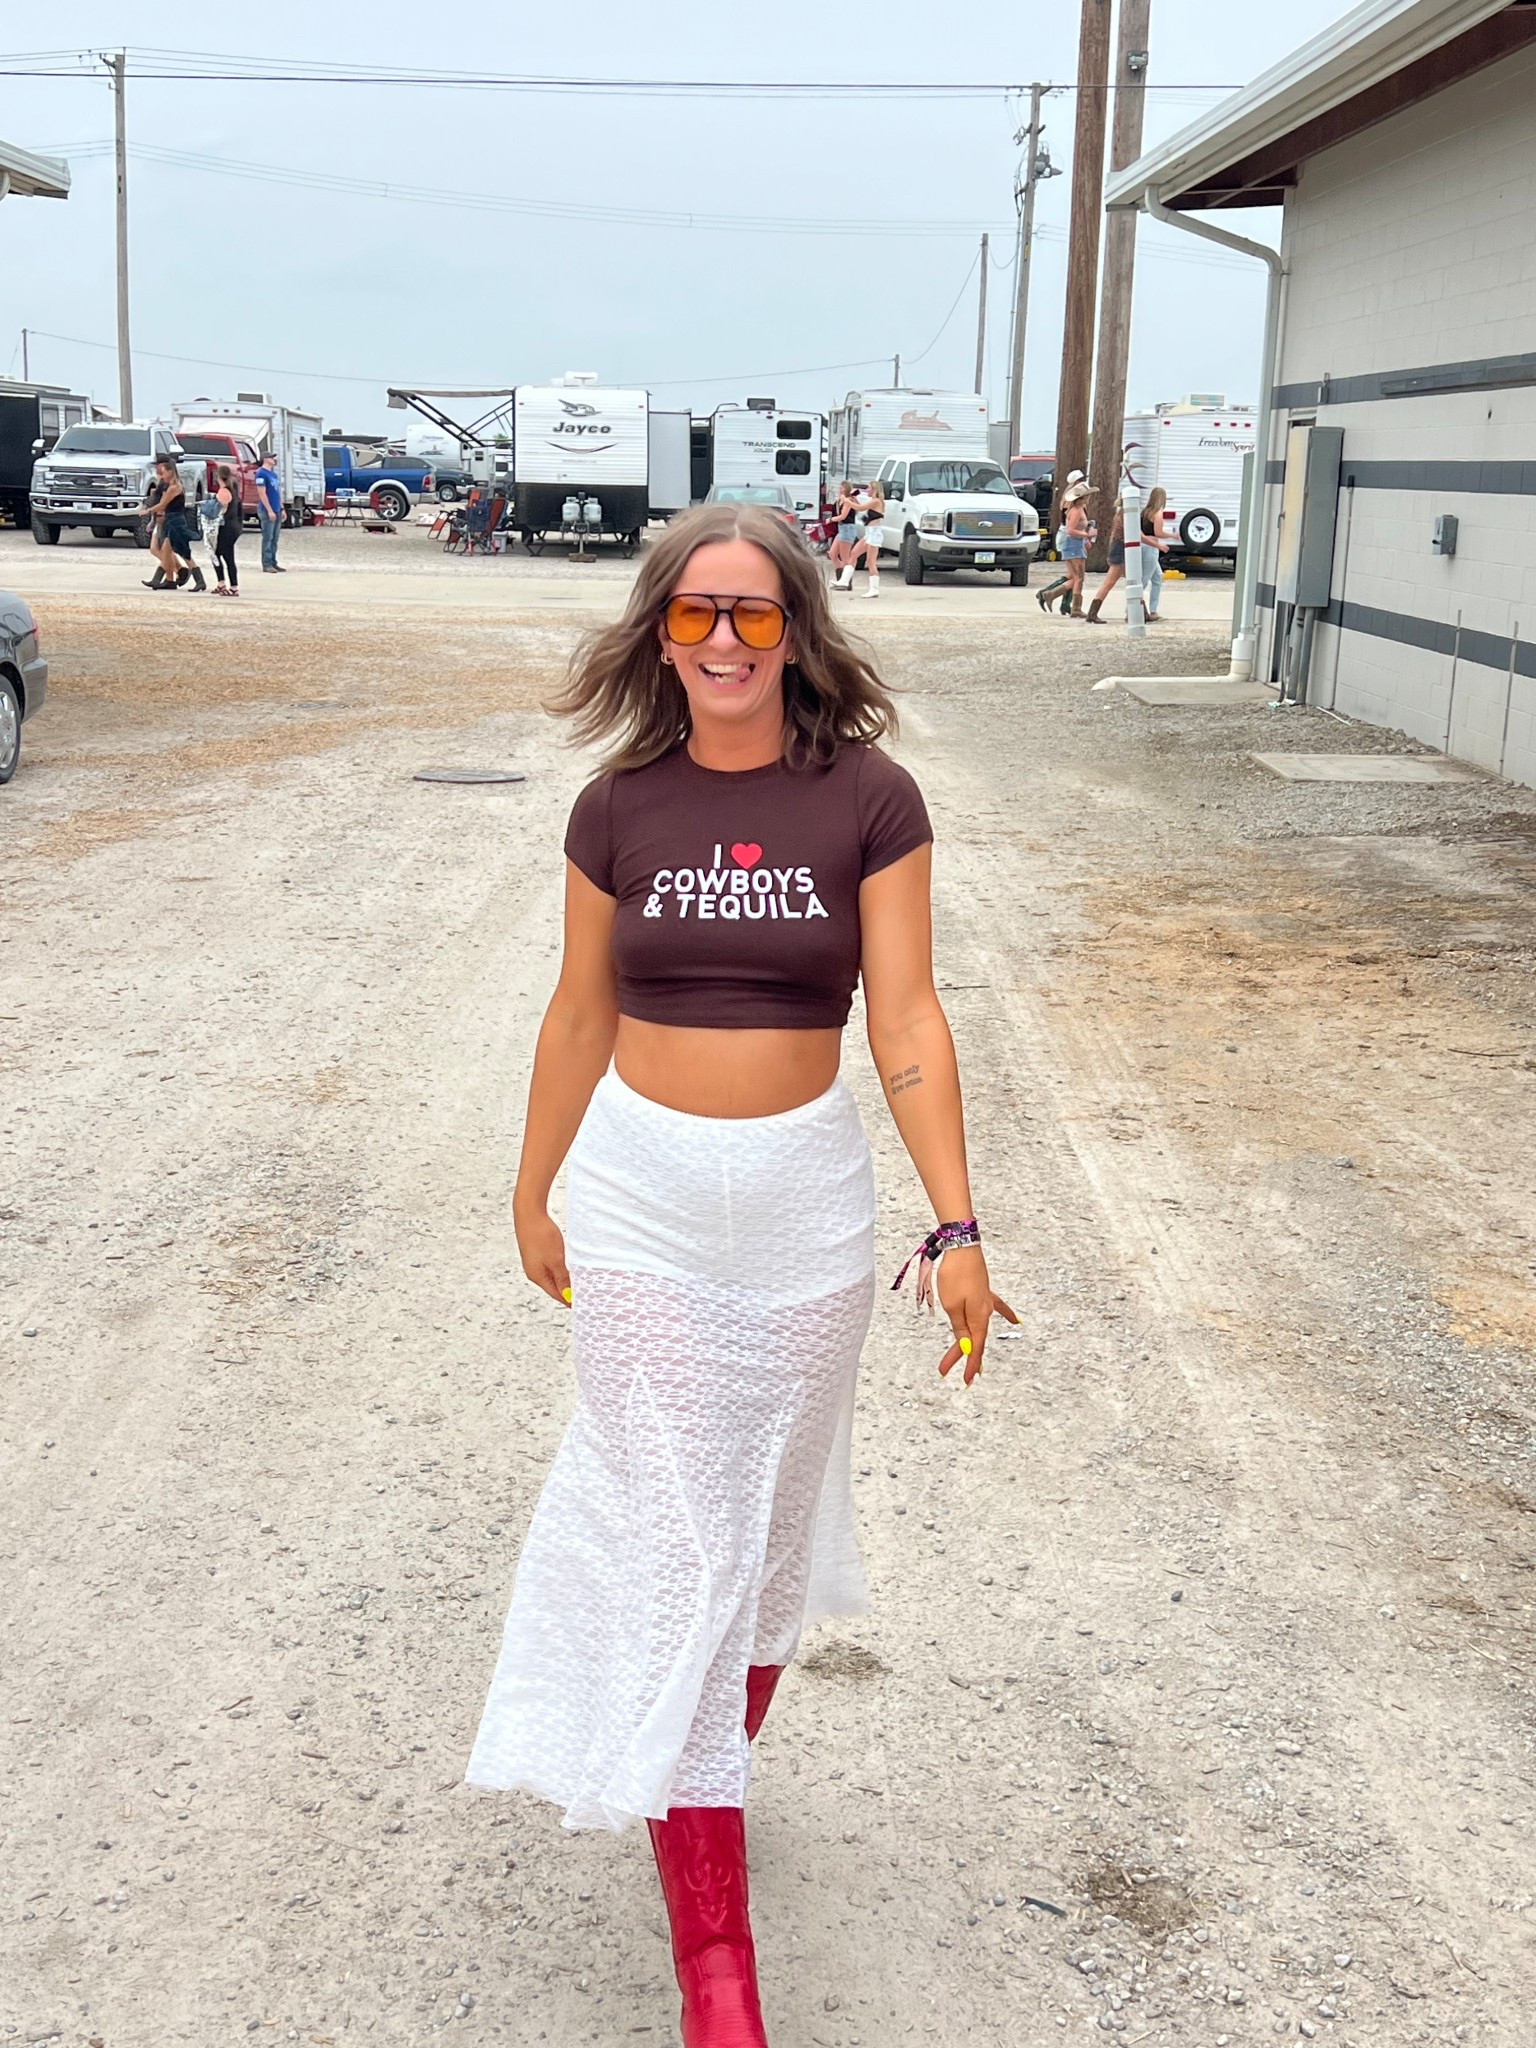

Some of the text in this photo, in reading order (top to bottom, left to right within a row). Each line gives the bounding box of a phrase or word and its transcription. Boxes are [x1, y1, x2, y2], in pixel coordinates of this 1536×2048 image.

[552, 421, 612, 436] Jayco
[713, 843, 722, 869] I
[653, 867, 814, 894] COWBOYS
[643, 893, 829, 919] & TEQUILA
